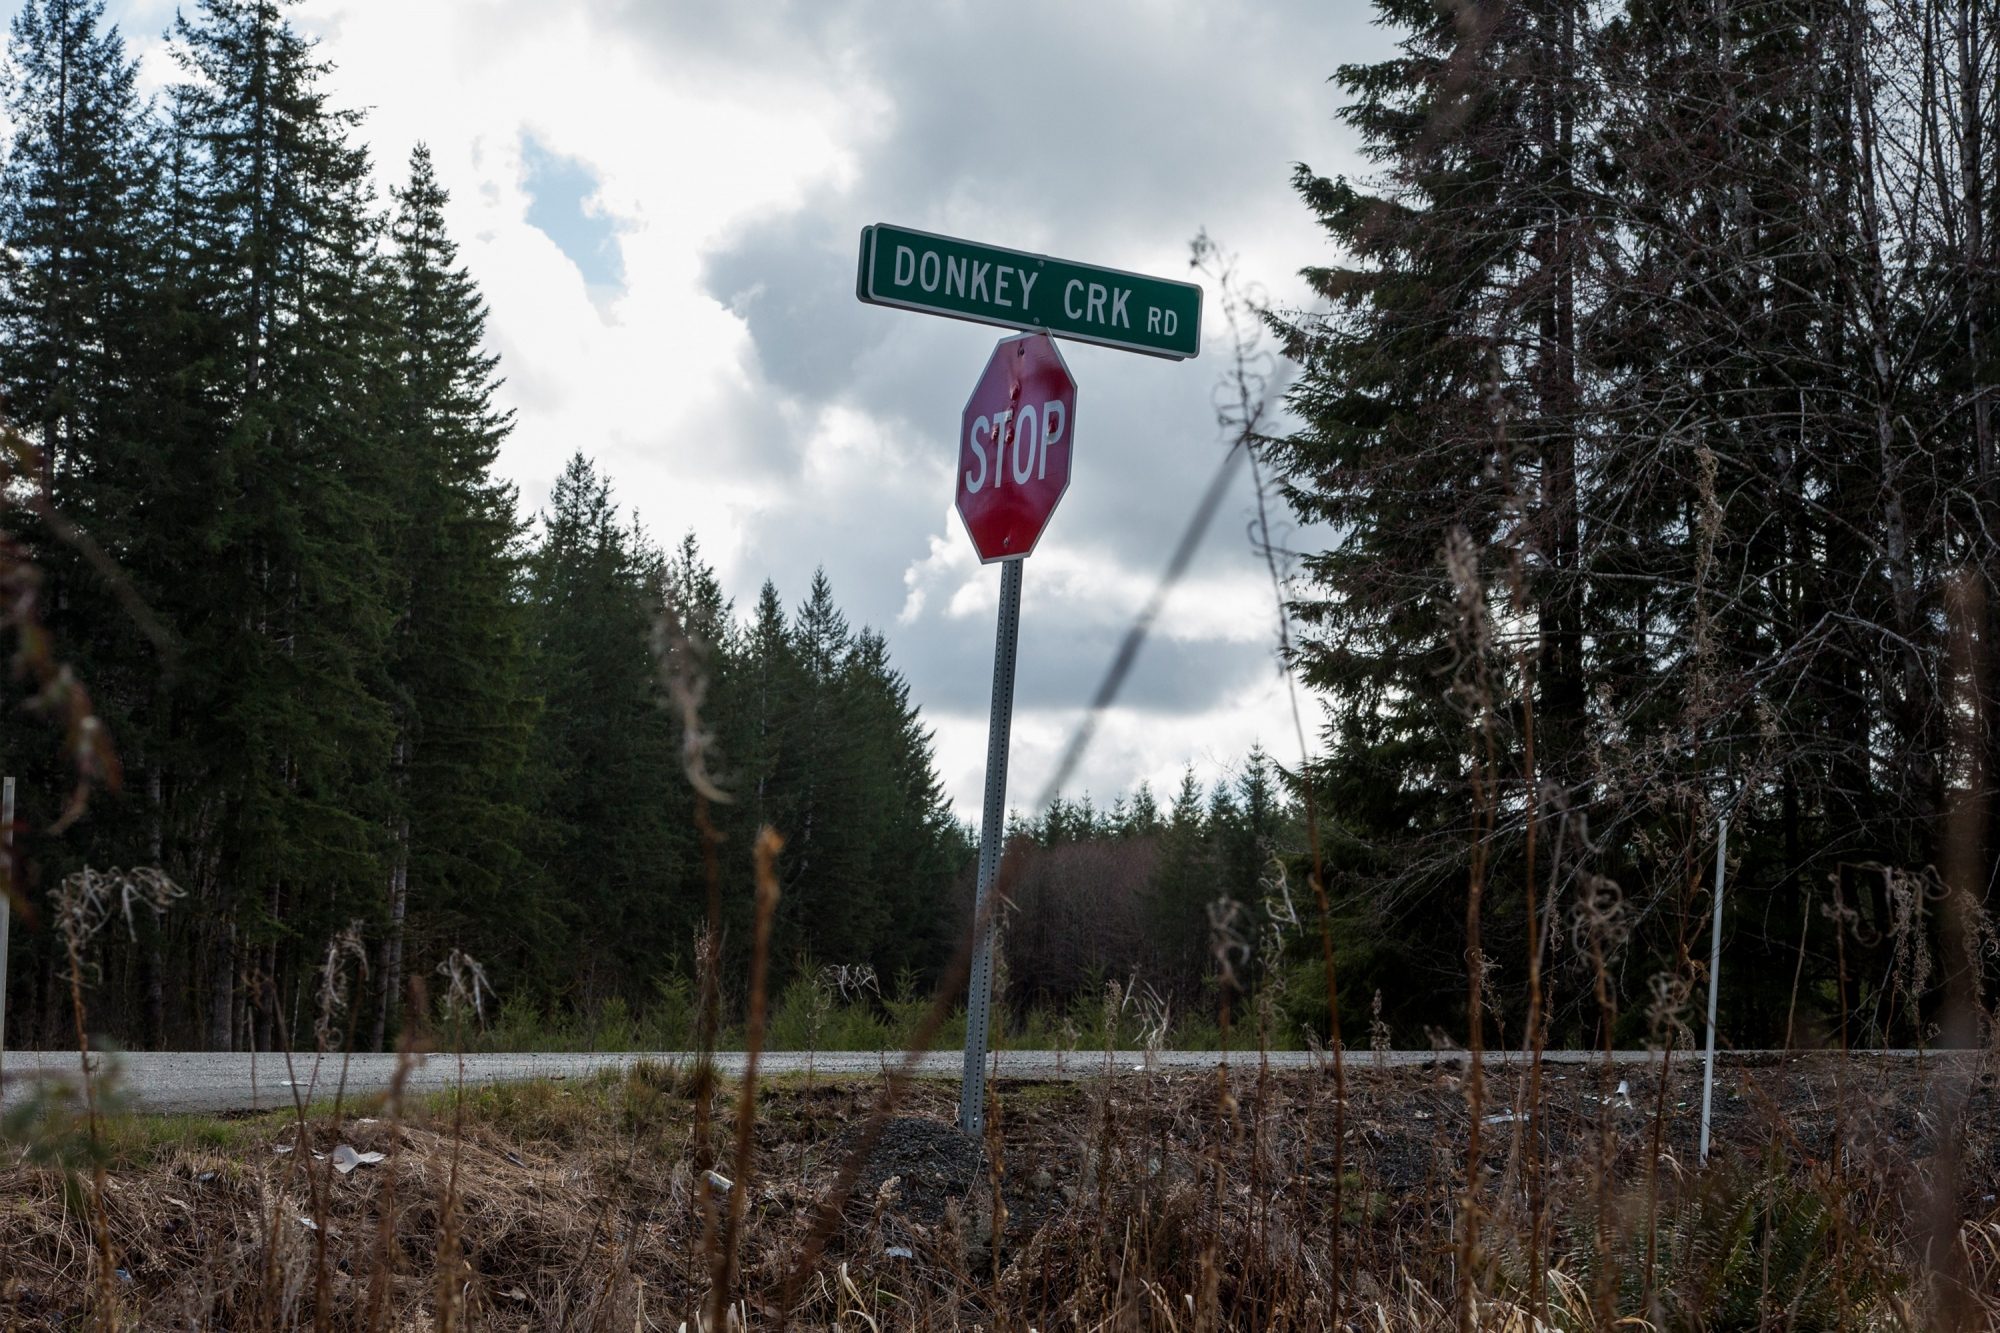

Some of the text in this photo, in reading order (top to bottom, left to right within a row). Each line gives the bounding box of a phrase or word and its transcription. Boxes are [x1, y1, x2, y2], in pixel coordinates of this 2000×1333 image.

[894, 245, 1178, 337] DONKEY CRK RD
[965, 399, 1066, 494] STOP
